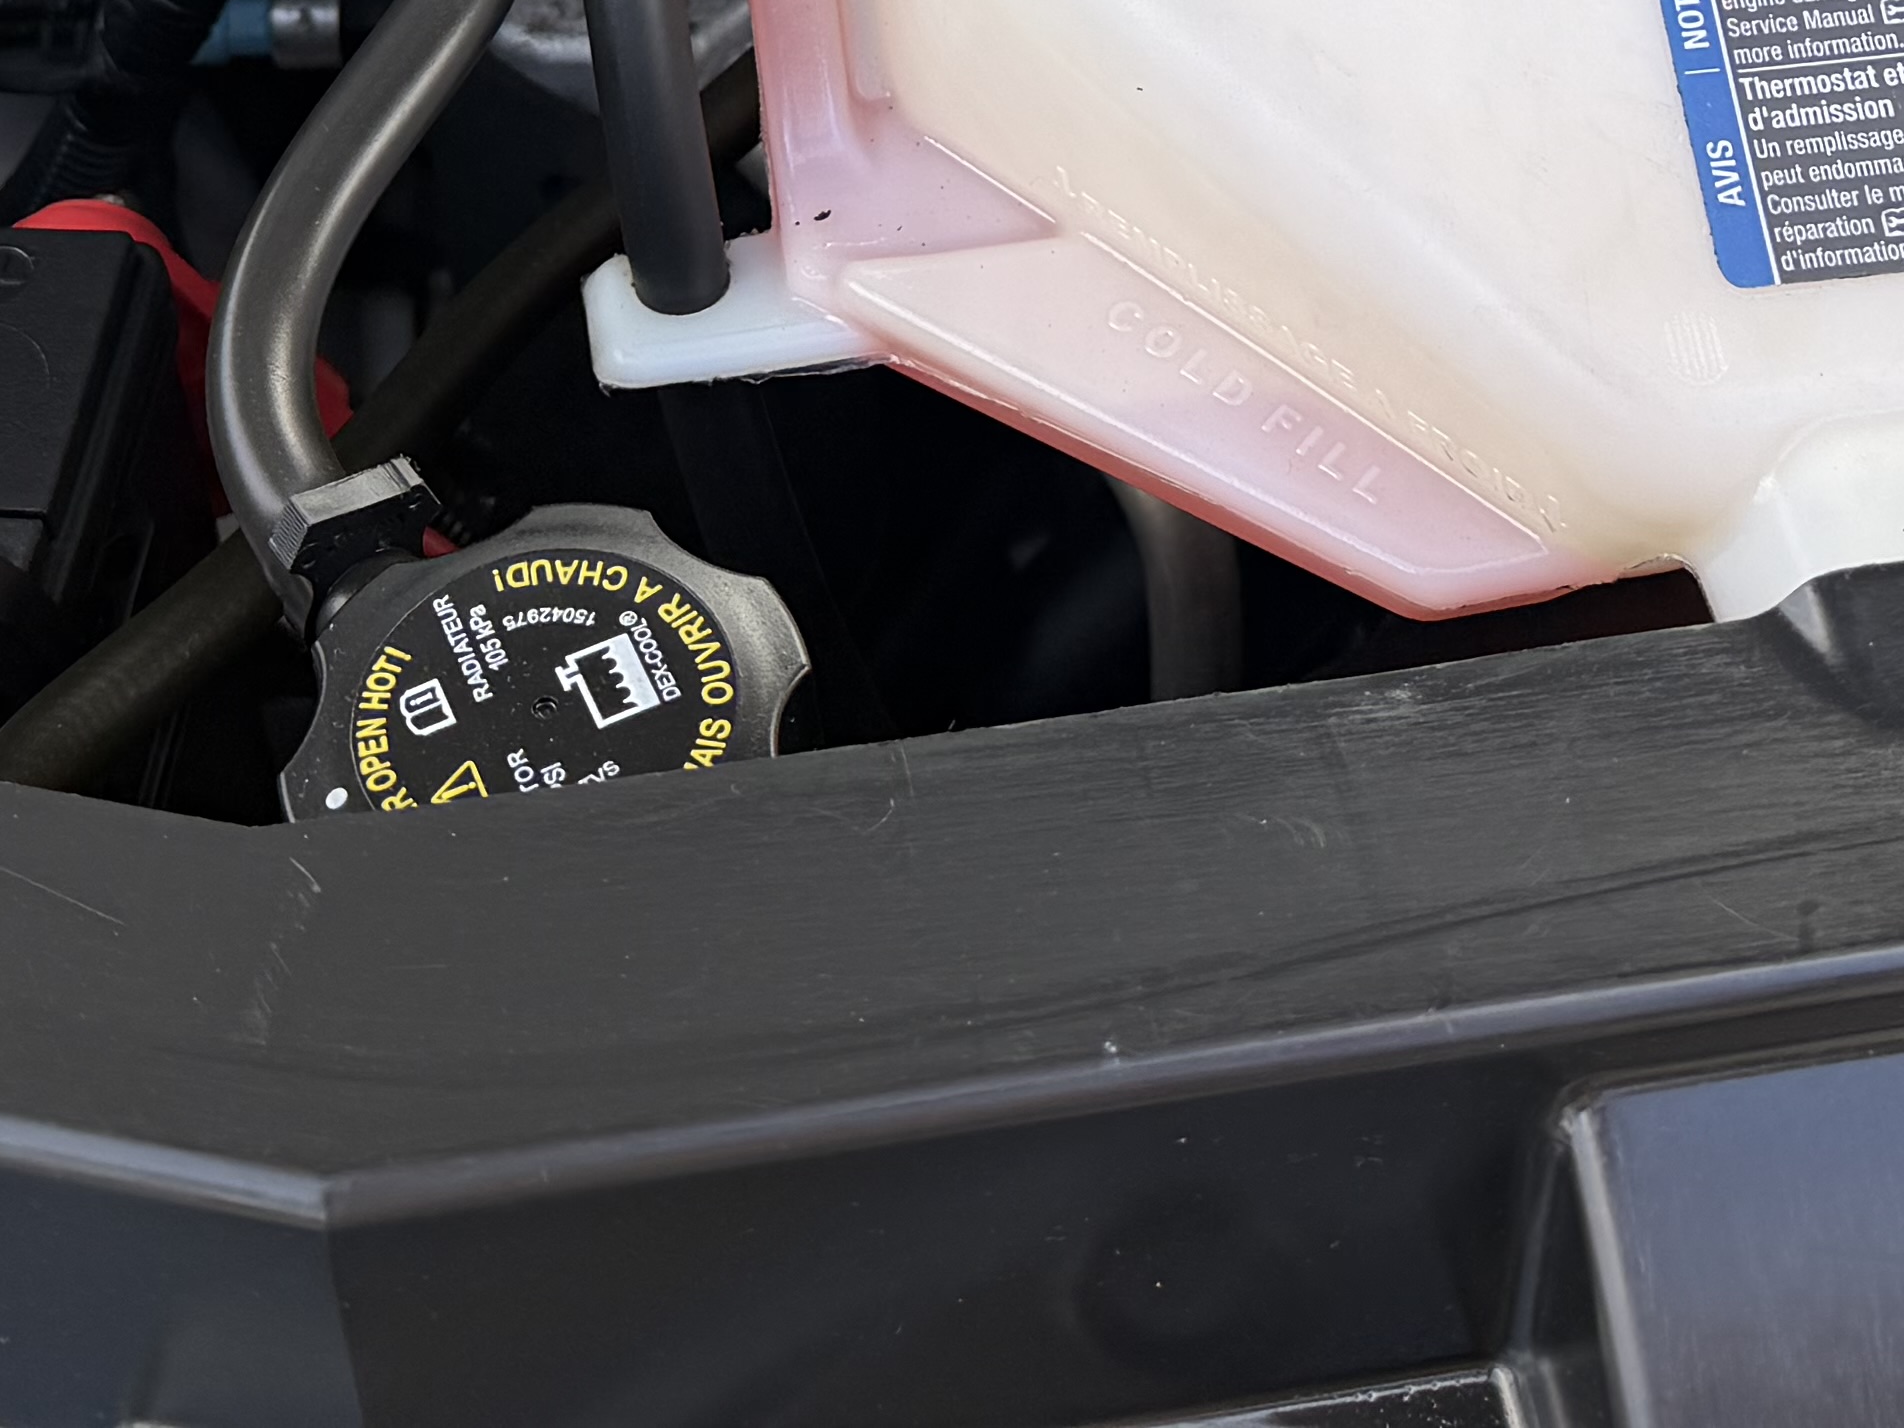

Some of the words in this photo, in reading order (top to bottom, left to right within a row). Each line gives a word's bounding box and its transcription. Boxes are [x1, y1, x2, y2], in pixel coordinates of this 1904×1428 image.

[1727, 13, 1798, 38] Service
[1804, 5, 1874, 31] Manual
[1734, 44, 1783, 65] more
[1788, 32, 1904, 58] information.
[1740, 70, 1878, 101] Thermostat
[1749, 96, 1895, 130] d'admission
[1754, 138, 1780, 159] Un
[1786, 127, 1904, 157] remplissage
[1707, 139, 1745, 207] AVIS
[1761, 166, 1804, 191] peut
[1767, 188, 1859, 214] Consulter
[1865, 184, 1883, 204] le
[1774, 216, 1874, 244] réparation
[1108, 301, 1252, 407] COLD
[1261, 405, 1380, 504] FILL
[492, 559, 628, 592] CHAUD!
[468, 603, 499, 638] kPa
[502, 607, 596, 631] 15042975
[433, 593, 493, 703] RADIATEUR
[482, 640, 510, 672] 105
[658, 592, 735, 704] OUVRIR
[360, 646, 413, 711] HOT!
[356, 717, 397, 790] OPEN
